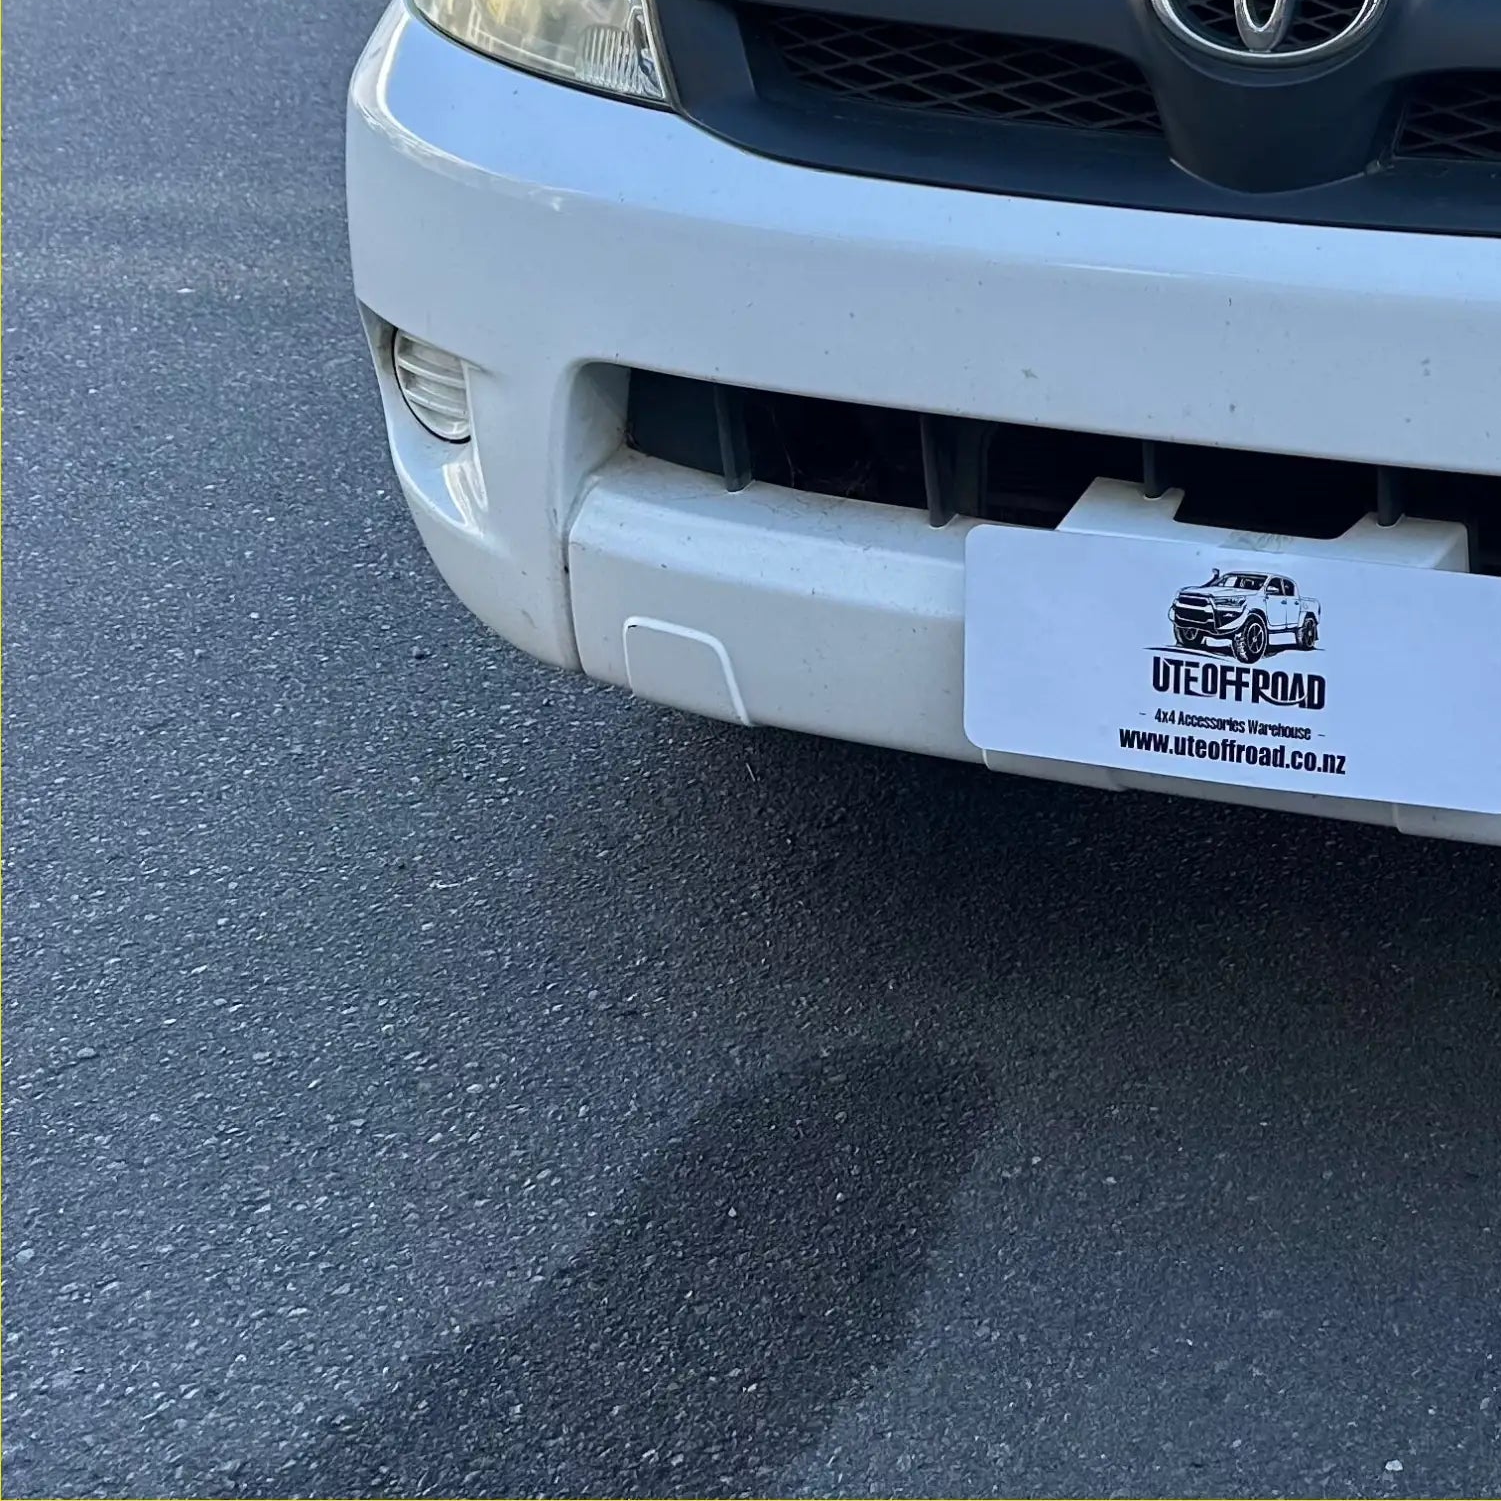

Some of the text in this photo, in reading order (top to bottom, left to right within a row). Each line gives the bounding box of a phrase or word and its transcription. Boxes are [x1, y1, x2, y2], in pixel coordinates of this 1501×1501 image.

[1154, 708, 1312, 741] 4x4 Accessories Warehouse
[1119, 728, 1347, 775] www.uteoffroad.co.nz
